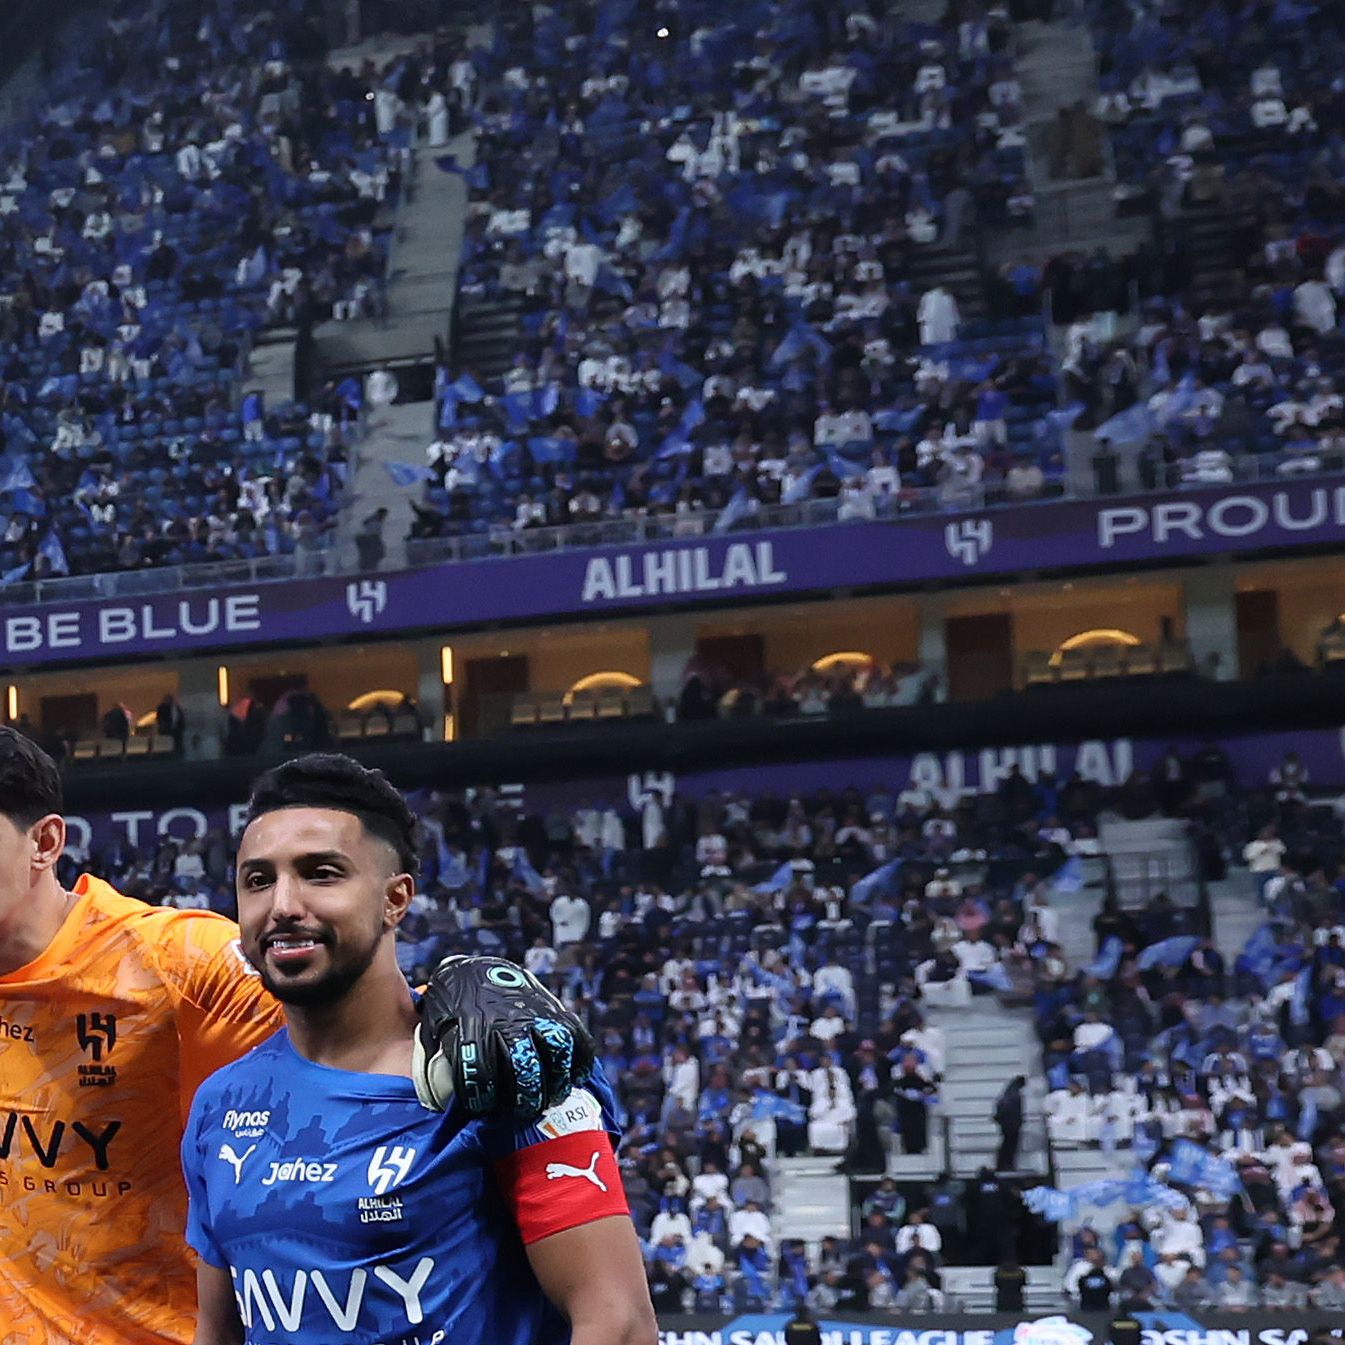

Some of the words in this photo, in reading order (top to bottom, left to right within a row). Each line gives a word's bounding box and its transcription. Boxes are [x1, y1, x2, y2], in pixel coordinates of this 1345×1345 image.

[1098, 487, 1345, 548] PROU
[581, 540, 787, 601] ALHILAL
[5, 612, 82, 652] BE
[99, 595, 261, 645] BLUE
[222, 1110, 271, 1131] flynas
[24, 1176, 132, 1197] GROUP
[358, 1197, 403, 1210] ALHILAL
